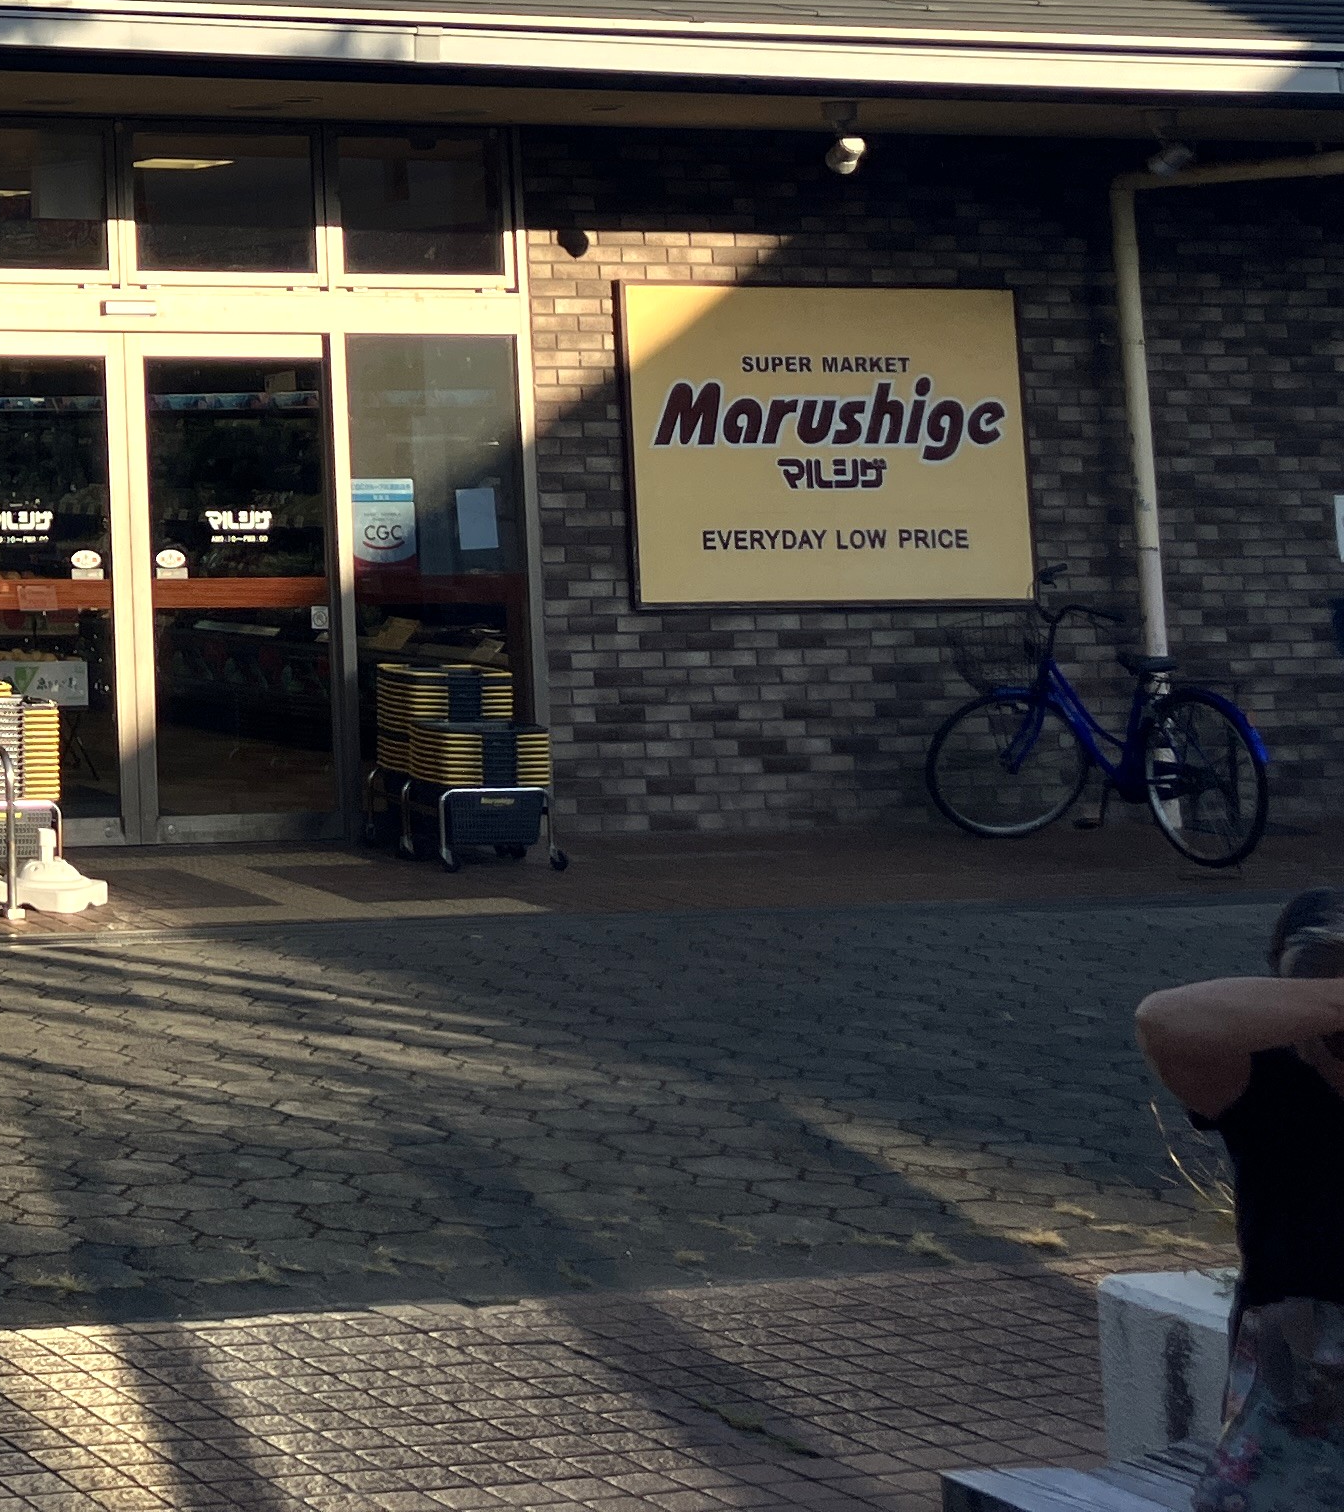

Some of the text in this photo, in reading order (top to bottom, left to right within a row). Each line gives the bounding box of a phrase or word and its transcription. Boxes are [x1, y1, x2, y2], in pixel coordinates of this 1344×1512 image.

[741, 356, 910, 374] SUPER MARKET
[653, 376, 1006, 461] Marushige
[776, 457, 888, 490] マルシゲ
[204, 510, 273, 530] マルシゲ
[364, 525, 403, 540] CGC
[702, 529, 970, 551] EVERYDAY LOW PRICE
